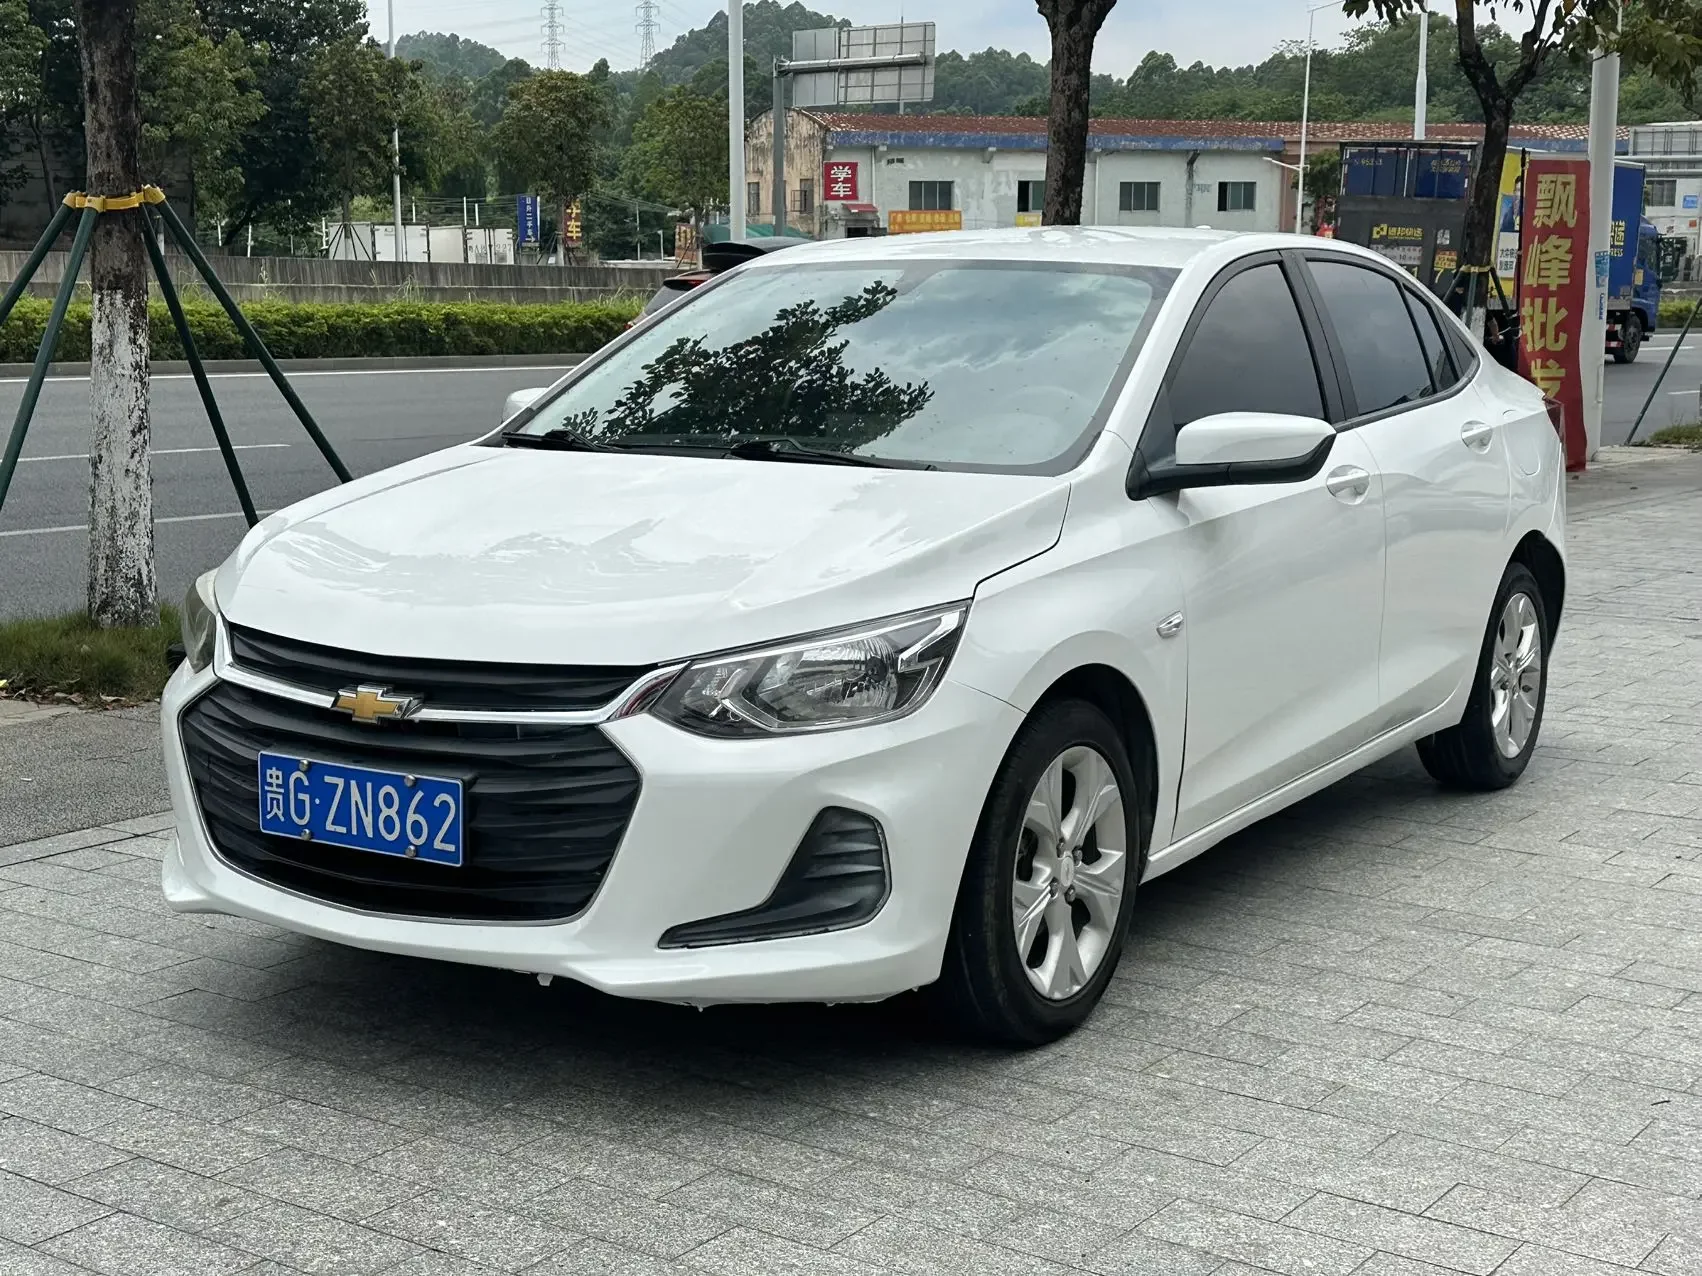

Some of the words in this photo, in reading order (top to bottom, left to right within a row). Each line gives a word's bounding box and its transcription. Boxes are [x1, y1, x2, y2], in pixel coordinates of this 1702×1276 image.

[830, 165, 852, 198] 学车
[1520, 173, 1578, 399] 飘峰批发
[264, 766, 456, 852] 贵G·ZN862
